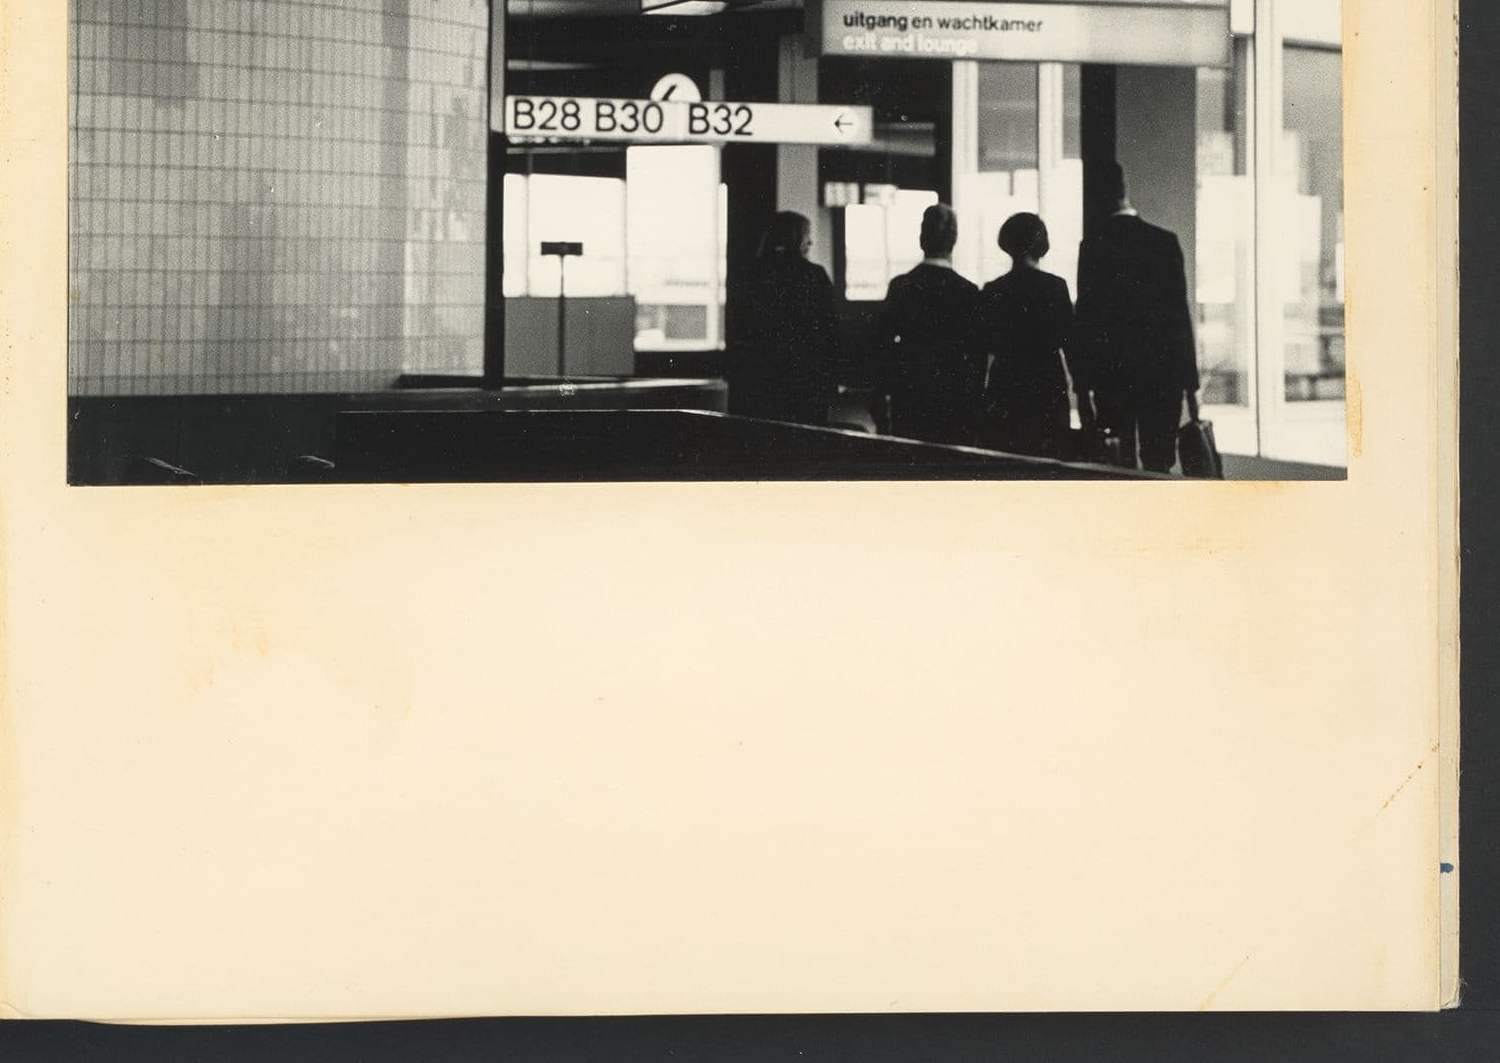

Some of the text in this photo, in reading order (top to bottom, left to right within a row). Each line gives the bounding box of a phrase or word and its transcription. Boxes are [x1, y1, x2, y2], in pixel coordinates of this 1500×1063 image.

[843, 11, 1043, 33] uitgang en wachtkamer
[842, 33, 979, 57] exit and lounge
[513, 98, 754, 136] B28 B30 B32
